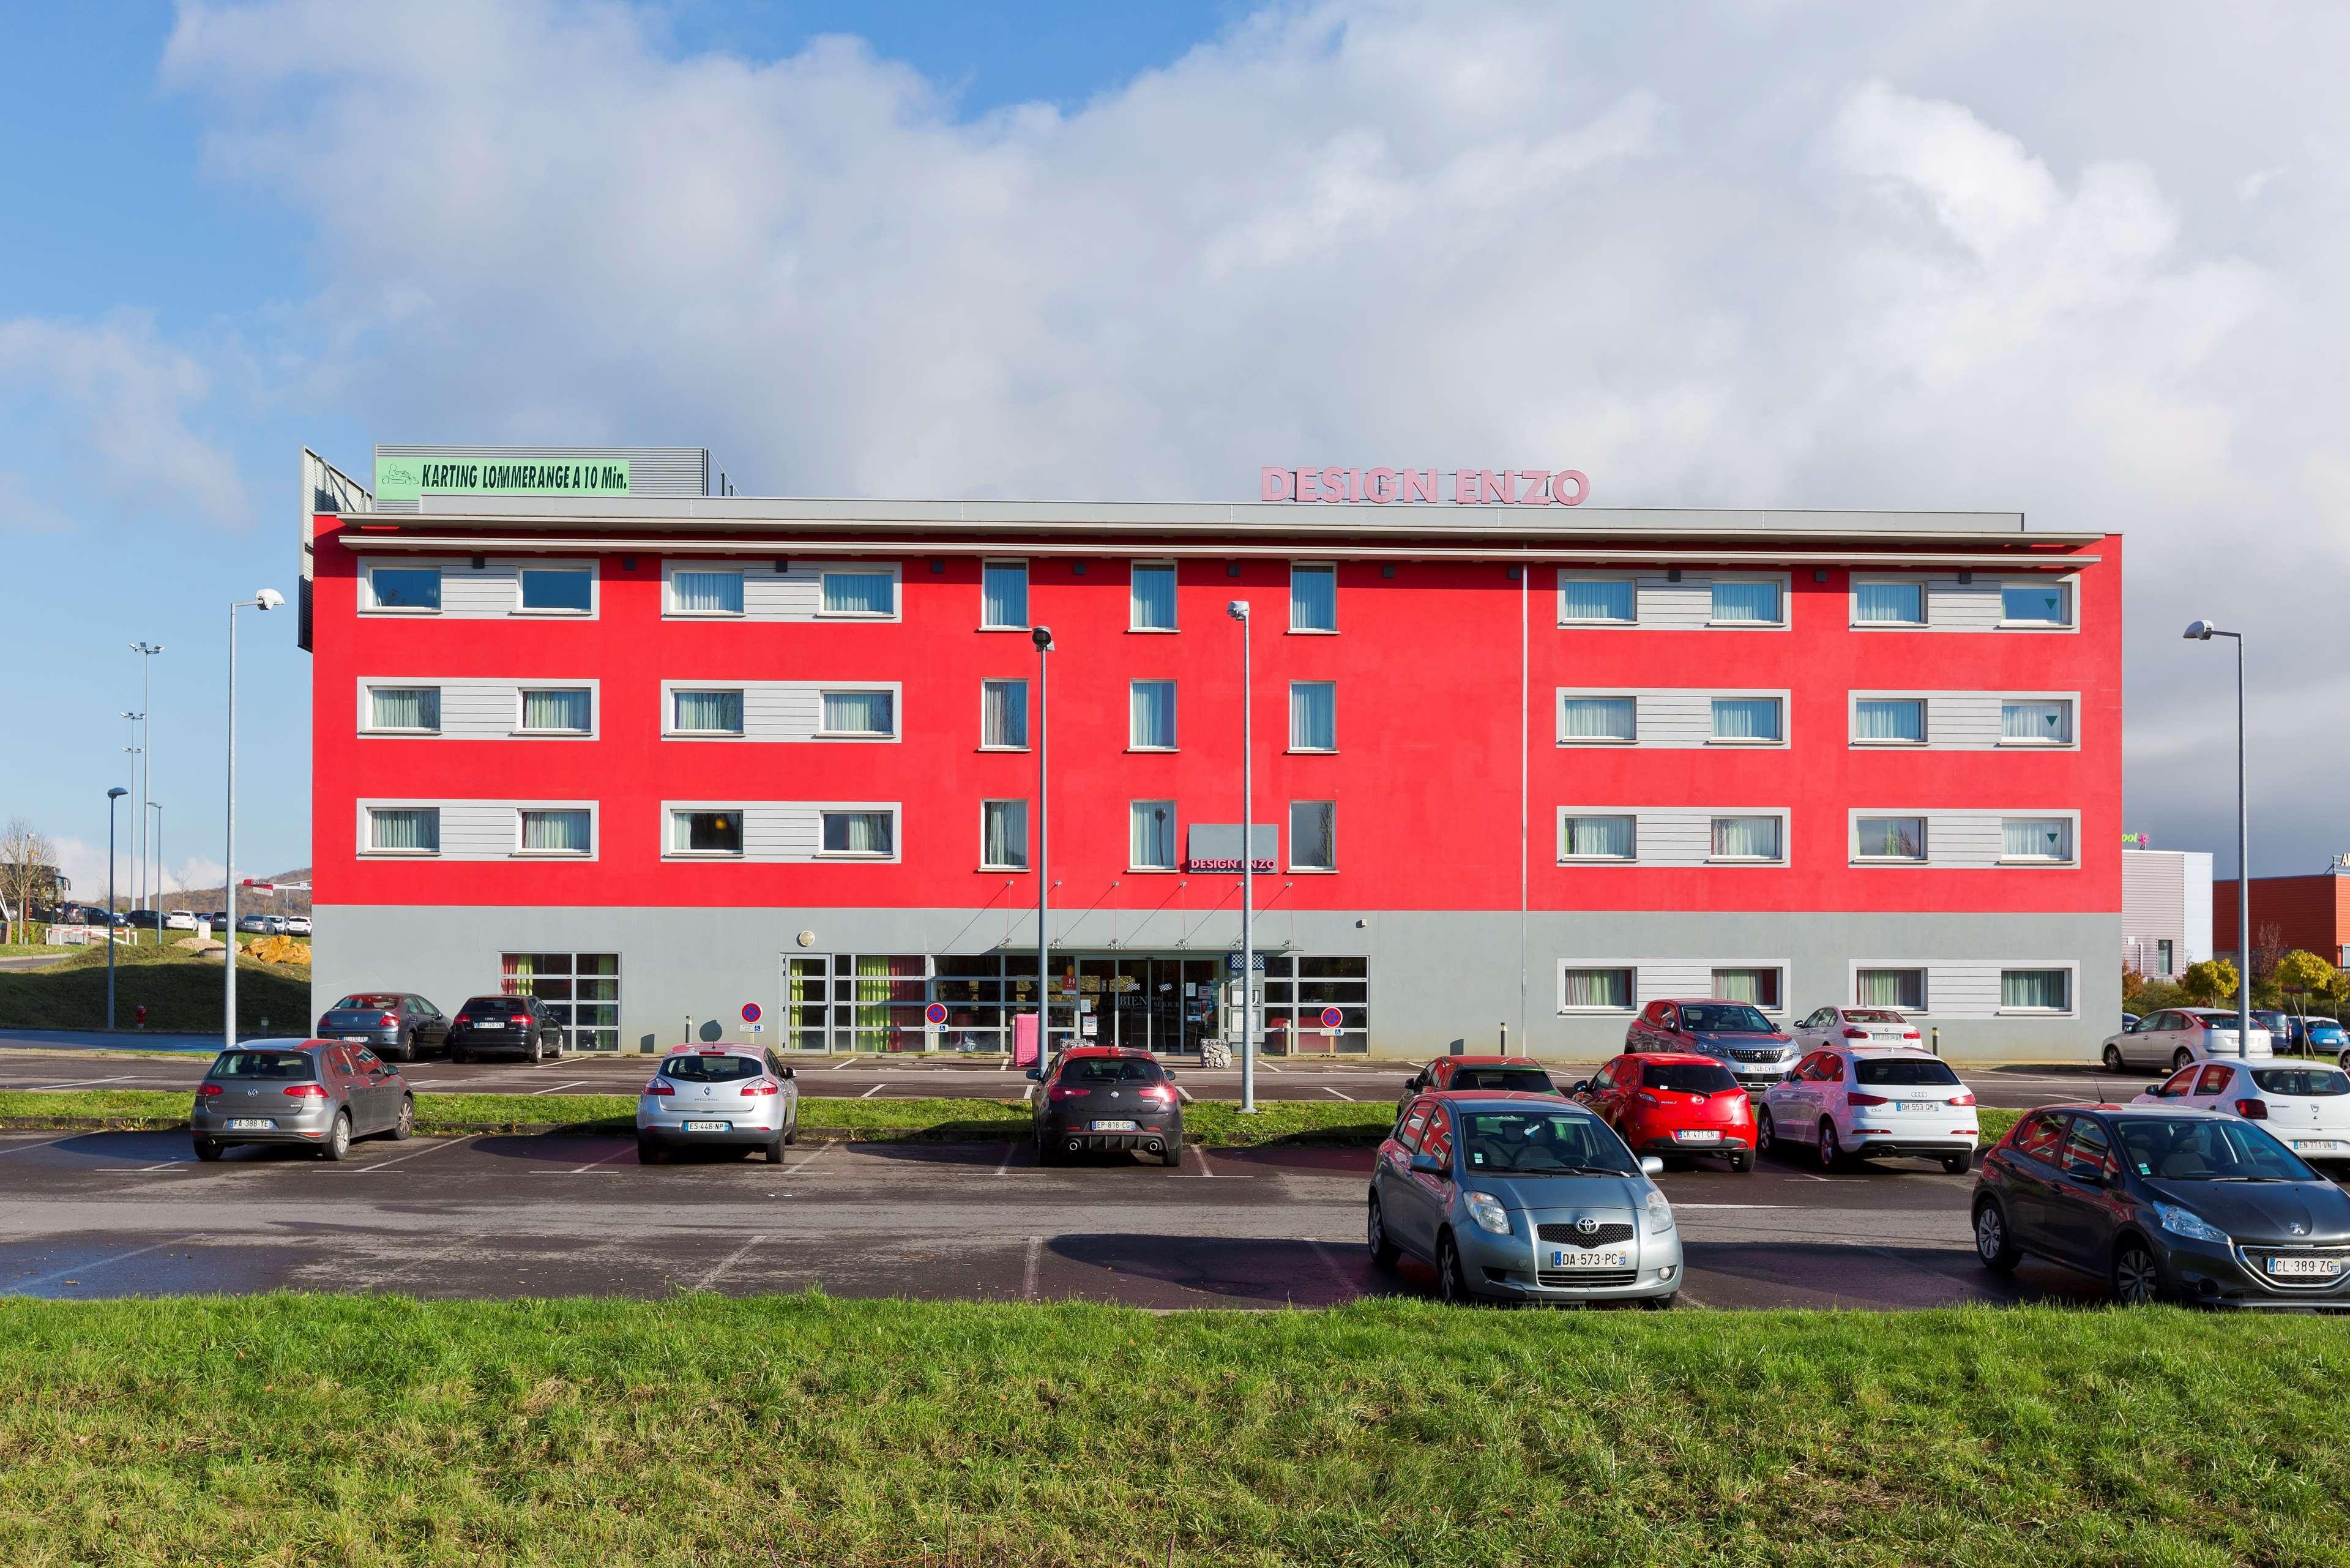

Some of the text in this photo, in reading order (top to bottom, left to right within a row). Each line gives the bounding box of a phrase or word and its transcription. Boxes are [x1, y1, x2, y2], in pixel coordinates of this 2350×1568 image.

[422, 465, 627, 489] KARTING LOMMERANGE A 10 Min.
[1261, 467, 1591, 506] DESIGN ENZO
[1191, 859, 1237, 868] DESIGN
[1119, 996, 1147, 1005] BIEN
[1562, 1253, 1617, 1265] DA-573-PC
[2276, 1260, 2333, 1272] CL-389-ZG
